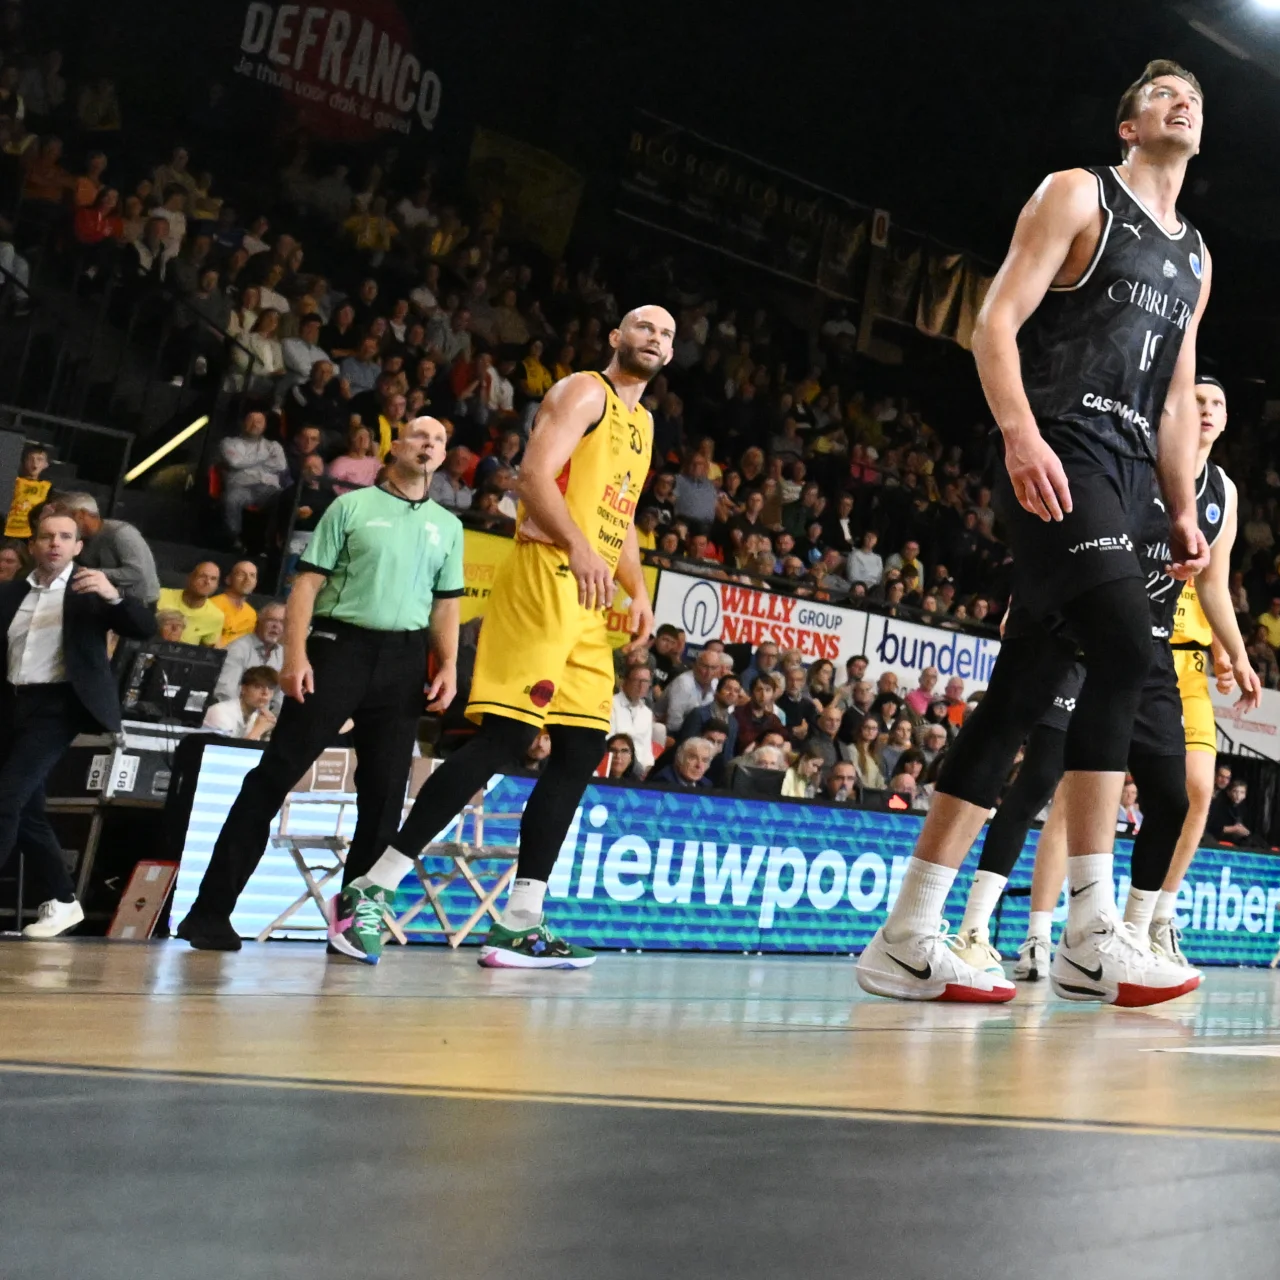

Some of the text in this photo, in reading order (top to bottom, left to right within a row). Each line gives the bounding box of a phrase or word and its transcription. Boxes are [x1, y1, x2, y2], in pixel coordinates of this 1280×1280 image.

[240, 1, 442, 131] DEFRANCQ
[597, 527, 624, 550] bwin
[1069, 536, 1118, 554] VINCI
[720, 584, 843, 630] WILLY GROUP
[720, 619, 841, 660] NAESSENS
